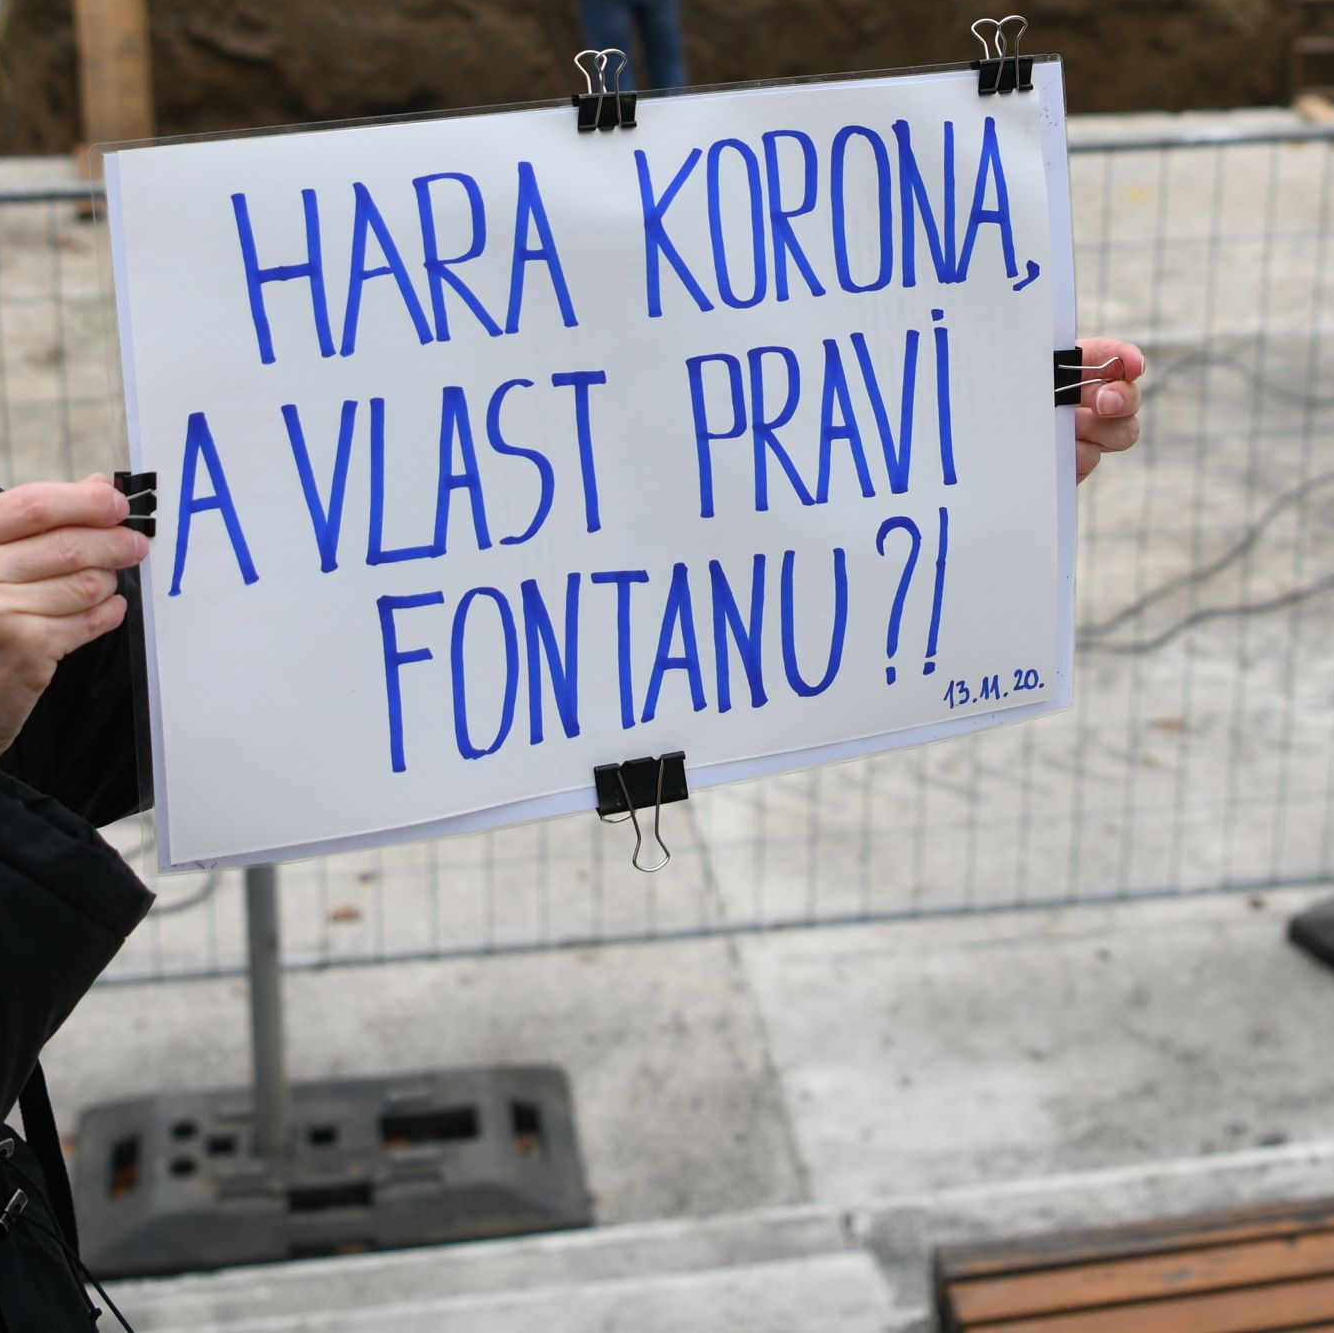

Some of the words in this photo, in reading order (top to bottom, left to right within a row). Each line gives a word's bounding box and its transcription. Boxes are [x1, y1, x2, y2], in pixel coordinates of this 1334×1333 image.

[230, 160, 579, 366] HARA
[634, 116, 1041, 319] KORONA,
[168, 411, 260, 598] A
[281, 370, 608, 575] VLAST
[685, 308, 958, 519] PRAVI
